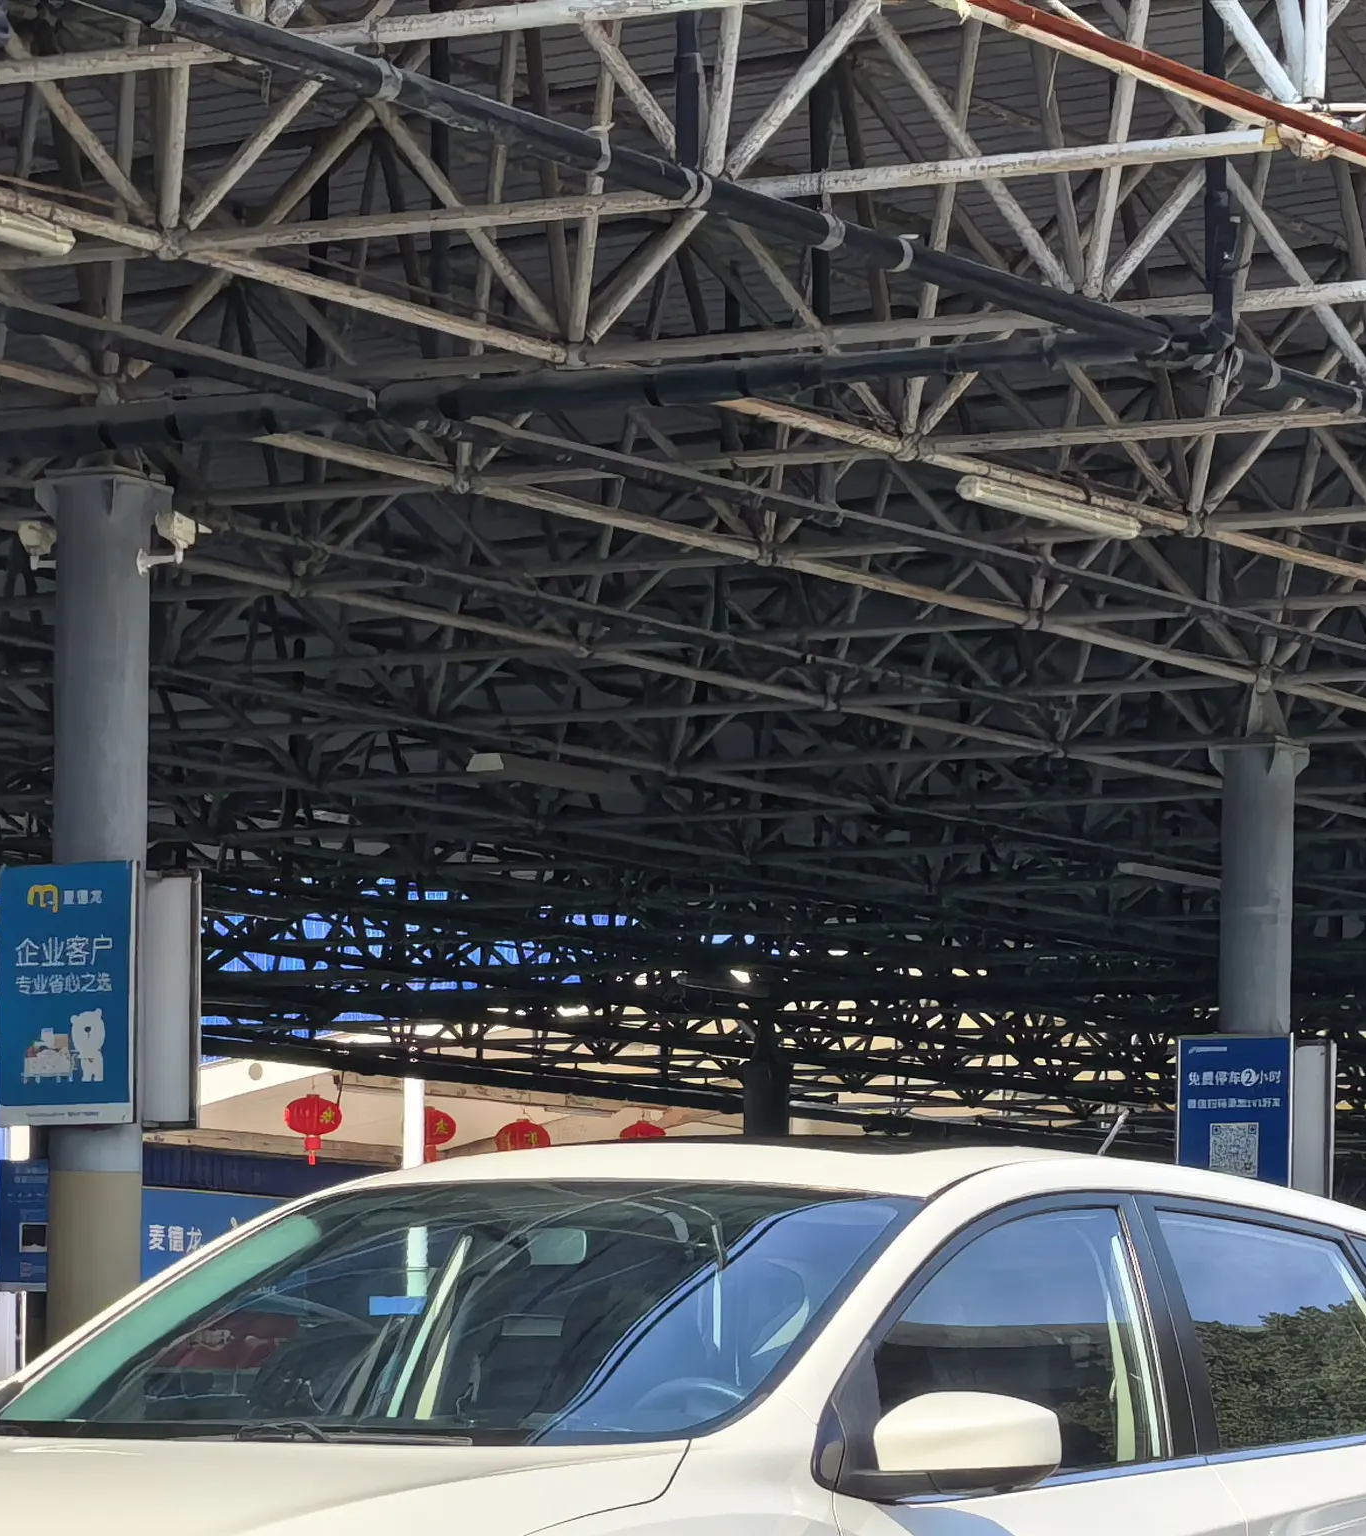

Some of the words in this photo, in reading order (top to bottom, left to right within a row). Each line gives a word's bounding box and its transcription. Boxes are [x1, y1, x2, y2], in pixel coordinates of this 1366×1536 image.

[15, 935, 113, 967] 企业客户
[15, 971, 113, 995] 专业省心之选
